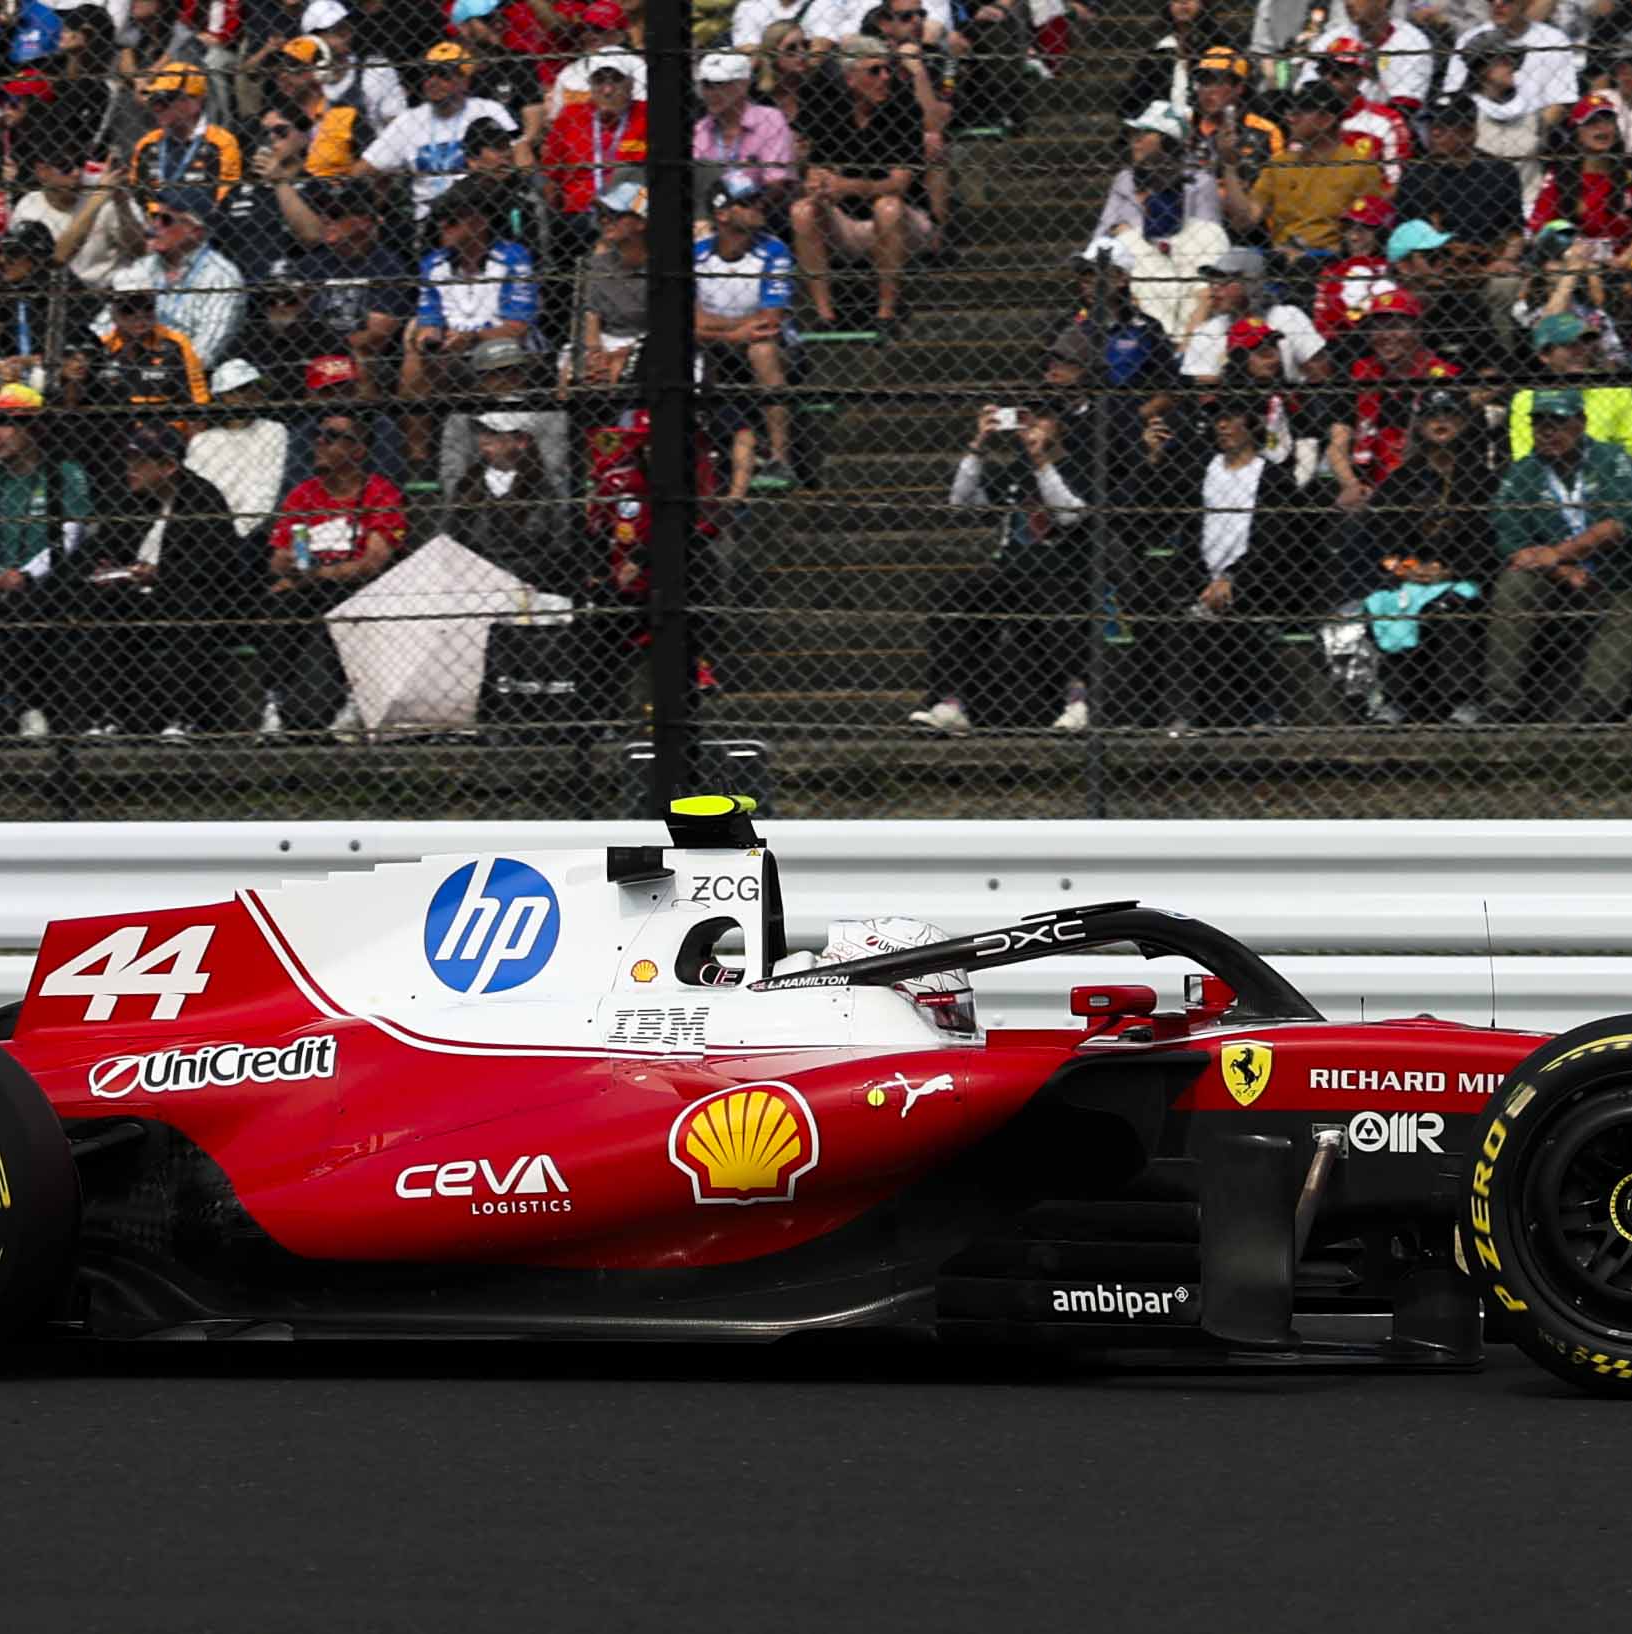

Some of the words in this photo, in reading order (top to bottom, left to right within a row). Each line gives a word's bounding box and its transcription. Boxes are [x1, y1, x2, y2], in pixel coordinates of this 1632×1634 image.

[692, 876, 760, 901] ZCG
[433, 857, 552, 994] hp
[973, 919, 1086, 957] DXC
[39, 925, 216, 1020] 44
[767, 976, 850, 989] L.HAMILTON
[607, 1007, 710, 1046] IBM
[144, 1036, 333, 1088] UniCredit
[1310, 1069, 1446, 1093] RICHARD
[472, 1200, 572, 1215] LOGISTICS
[1471, 1118, 1507, 1272] ZERO
